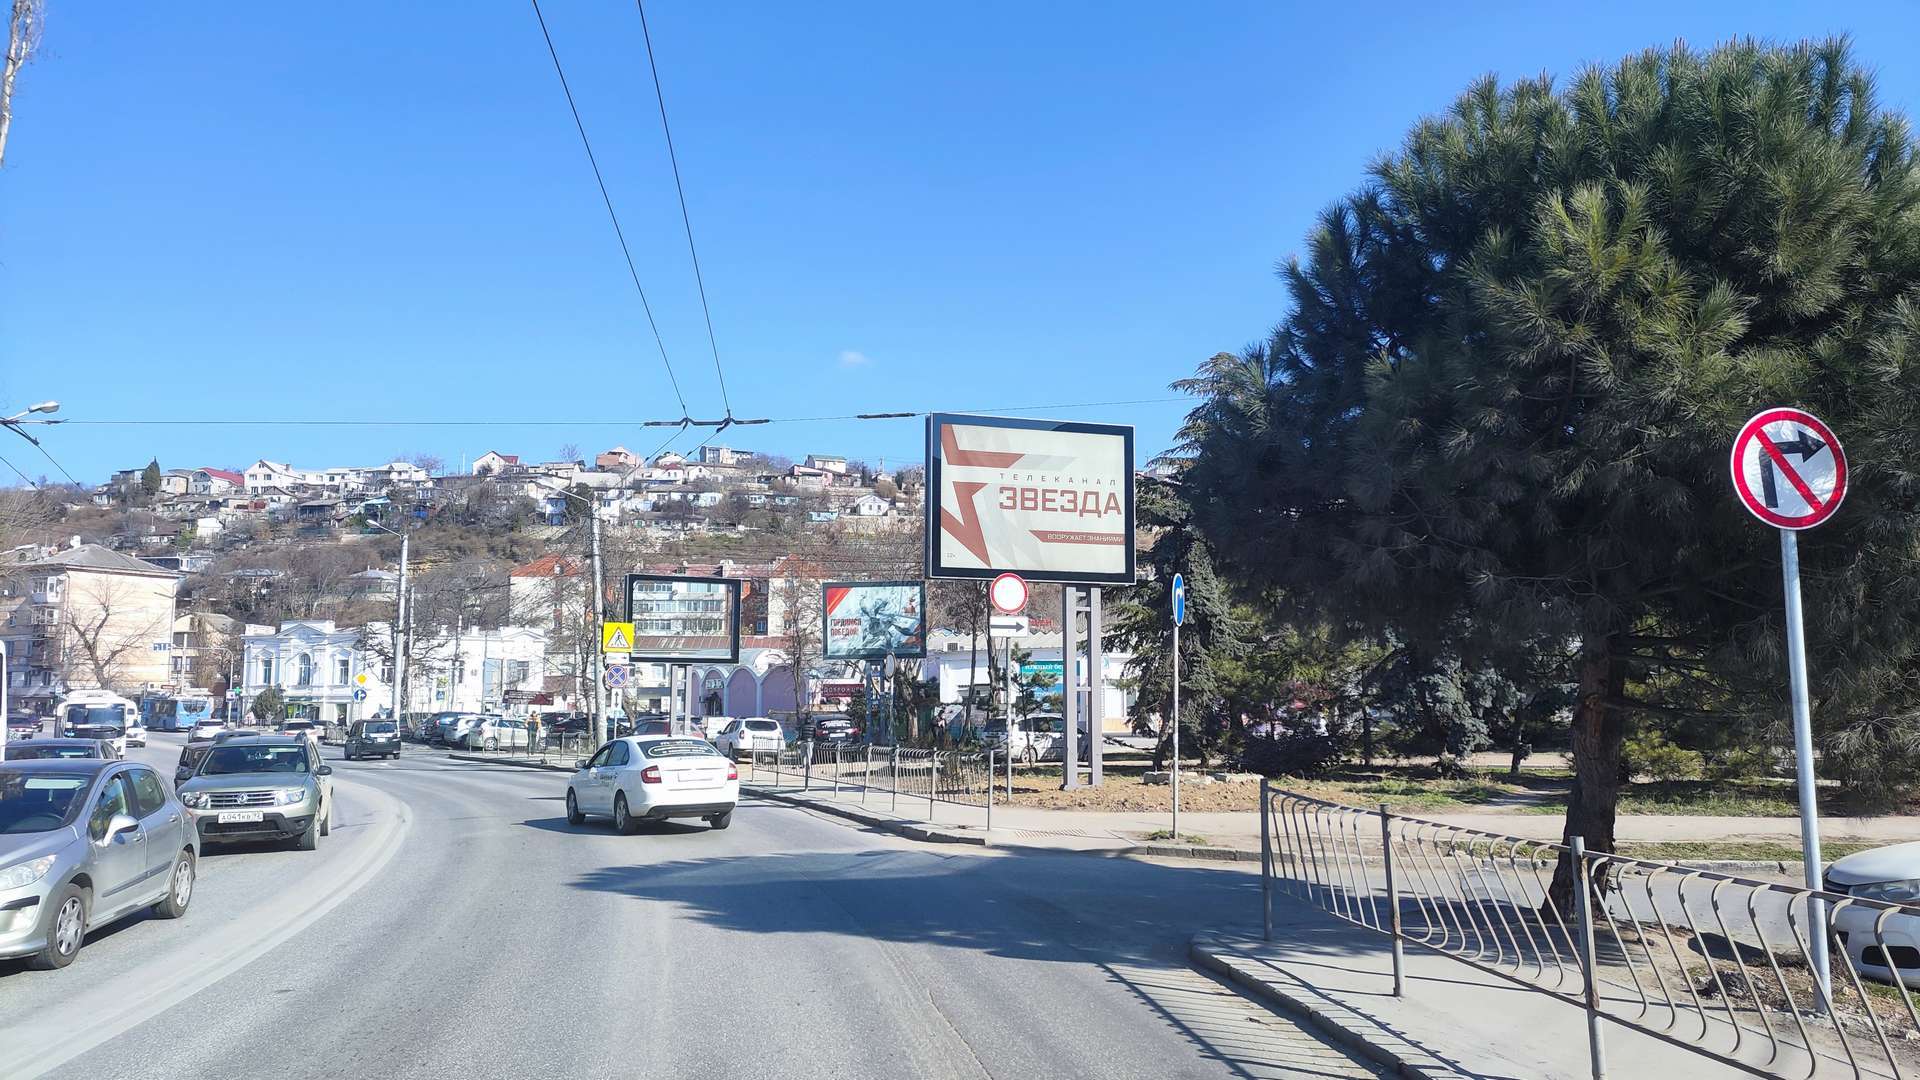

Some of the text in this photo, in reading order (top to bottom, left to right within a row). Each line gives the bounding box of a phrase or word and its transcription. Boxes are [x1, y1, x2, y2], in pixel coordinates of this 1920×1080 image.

[999, 472, 1116, 486] ТЕЛЕКАНАЛ
[999, 486, 1122, 518] ЗВЕЗДА
[1047, 533, 1086, 542] ВООРУЖАЕТ
